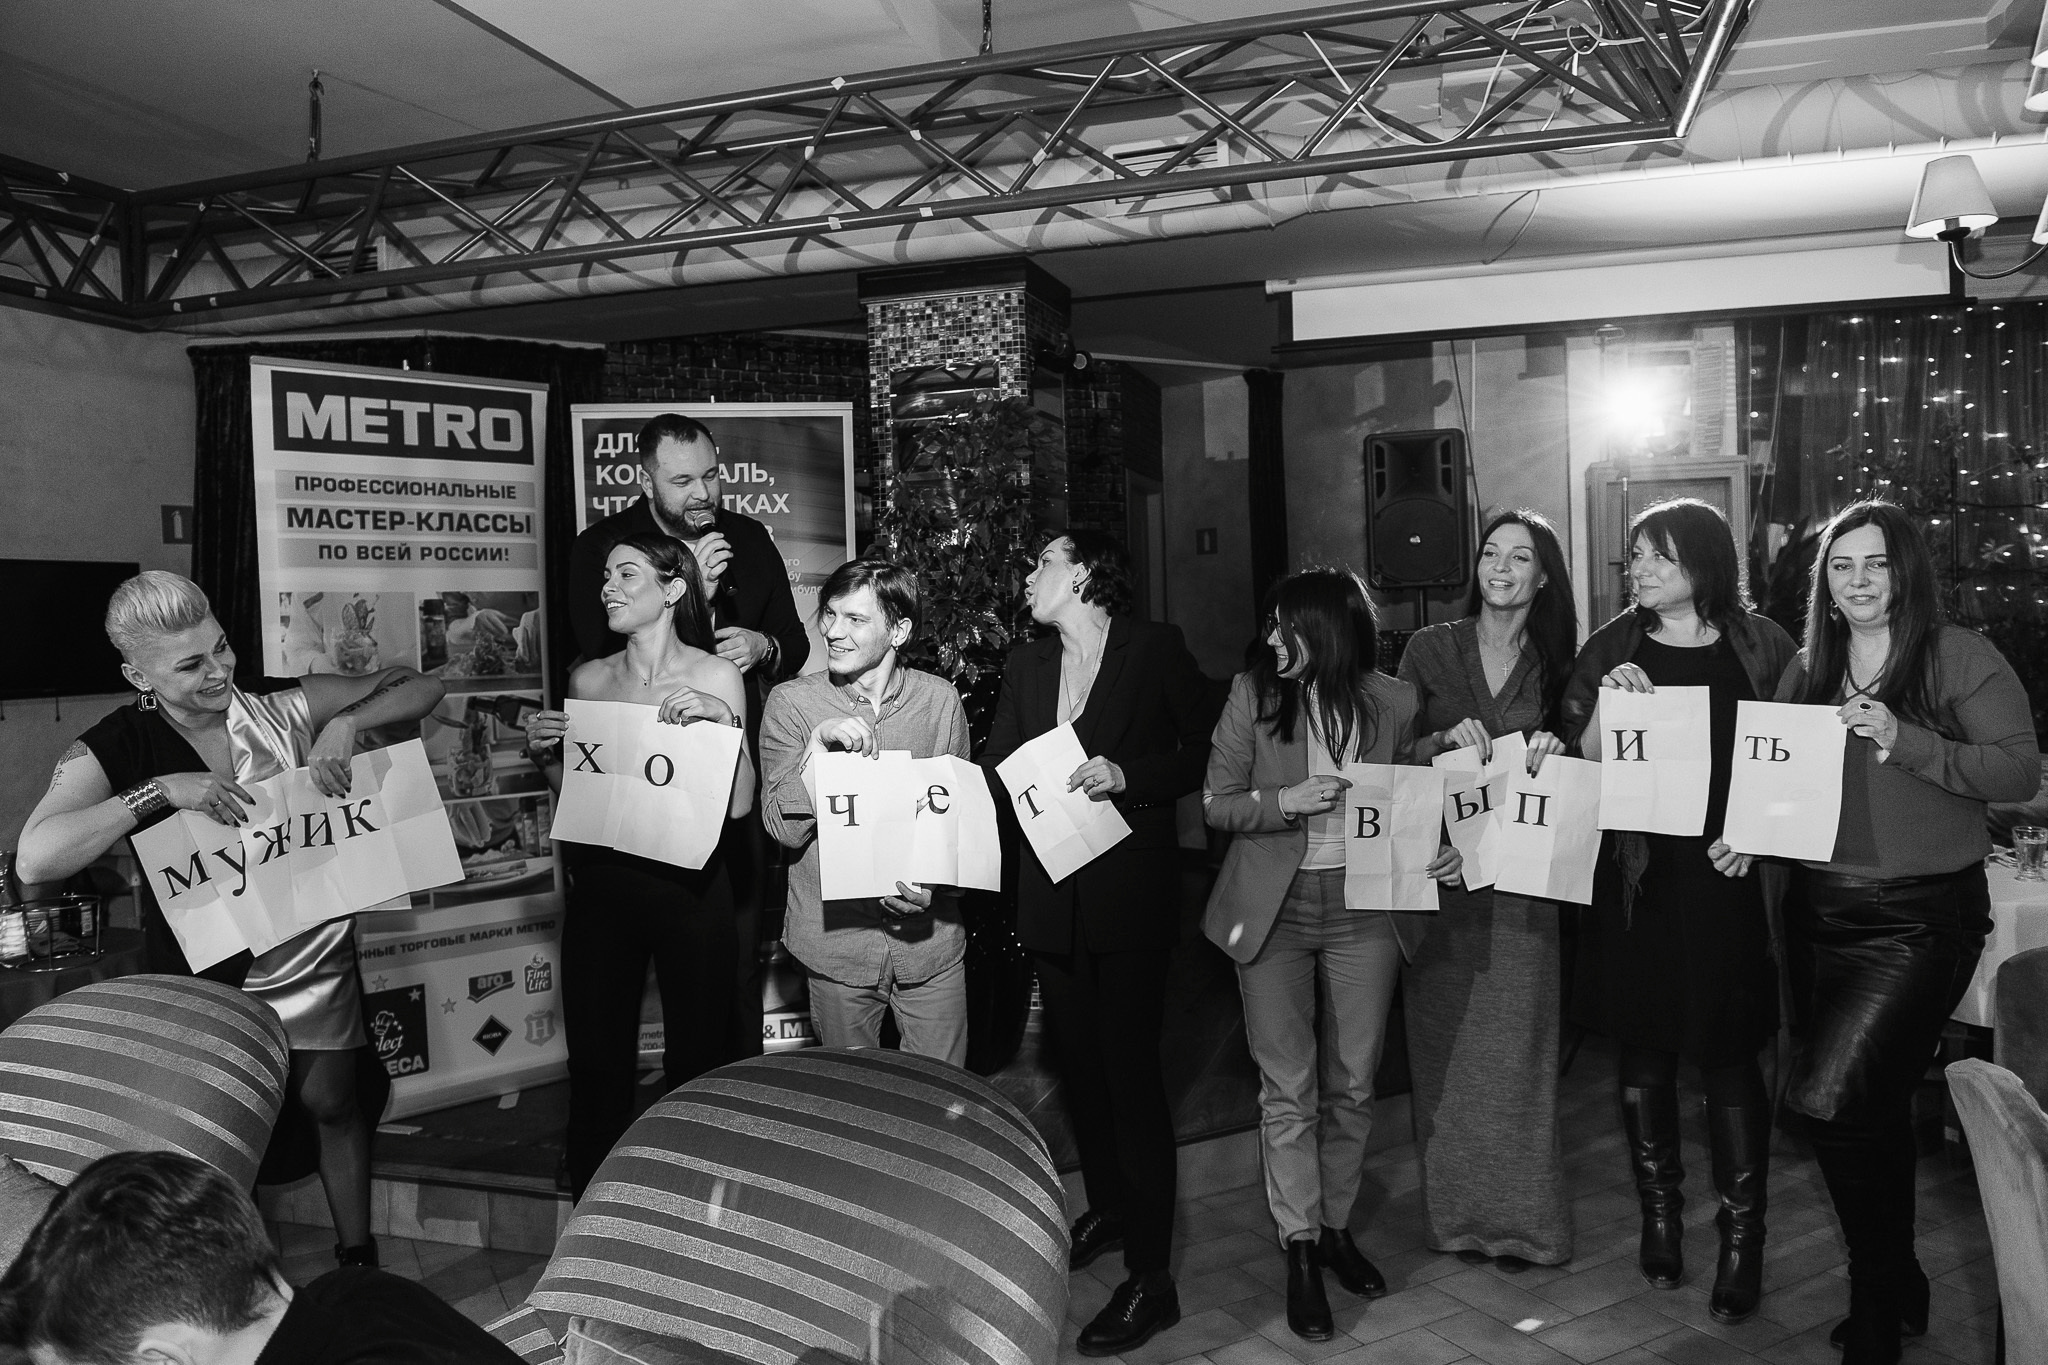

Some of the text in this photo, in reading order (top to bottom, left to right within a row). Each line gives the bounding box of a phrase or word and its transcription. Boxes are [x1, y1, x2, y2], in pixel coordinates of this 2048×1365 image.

[286, 391, 523, 452] METRO
[718, 462, 776, 487] АЛЬ,
[294, 475, 517, 500] ПРОФЕССИОНАЛЬНЫЕ
[721, 493, 791, 514] ТКАХ
[287, 507, 532, 534] МАСТЕР-КЛАССЫ
[318, 543, 510, 562] ПО ВСЕЙ РОССИИ!
[357, 919, 557, 961] ННЫЕ ТОРГОВЫЕ МАРКИ METRO
[477, 974, 505, 989] aro
[526, 969, 551, 983] Fine
[528, 979, 550, 992] Life
[384, 1055, 425, 1075] ECA
